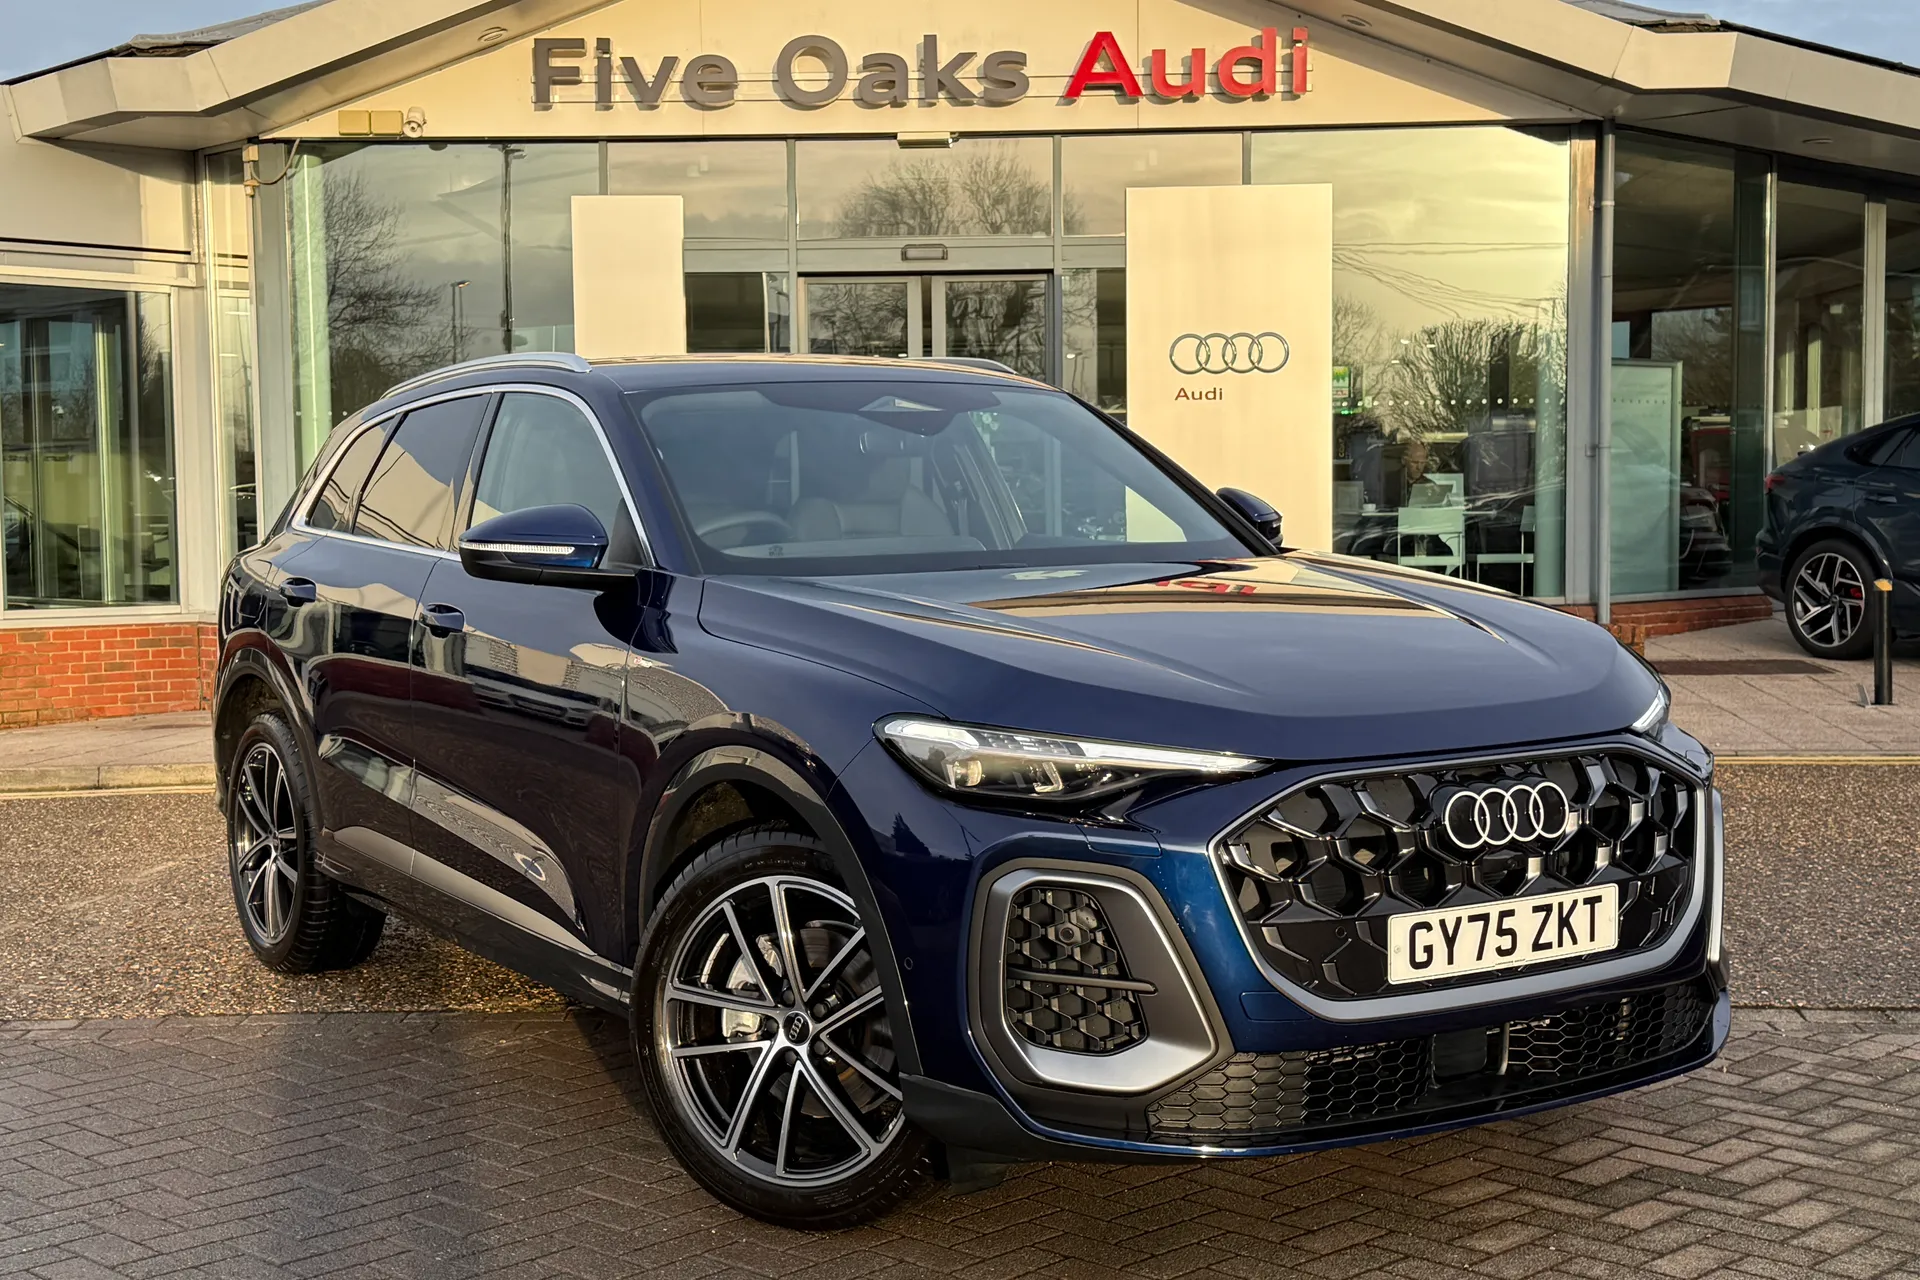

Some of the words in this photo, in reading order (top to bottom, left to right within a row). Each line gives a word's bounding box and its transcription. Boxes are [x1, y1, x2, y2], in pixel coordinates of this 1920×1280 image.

[533, 37, 738, 108] Five
[776, 34, 1030, 107] Oaks
[1063, 27, 1309, 98] Audi
[1174, 387, 1223, 401] Audi
[1408, 909, 1518, 971] GY75
[1531, 894, 1603, 953] ZKT
